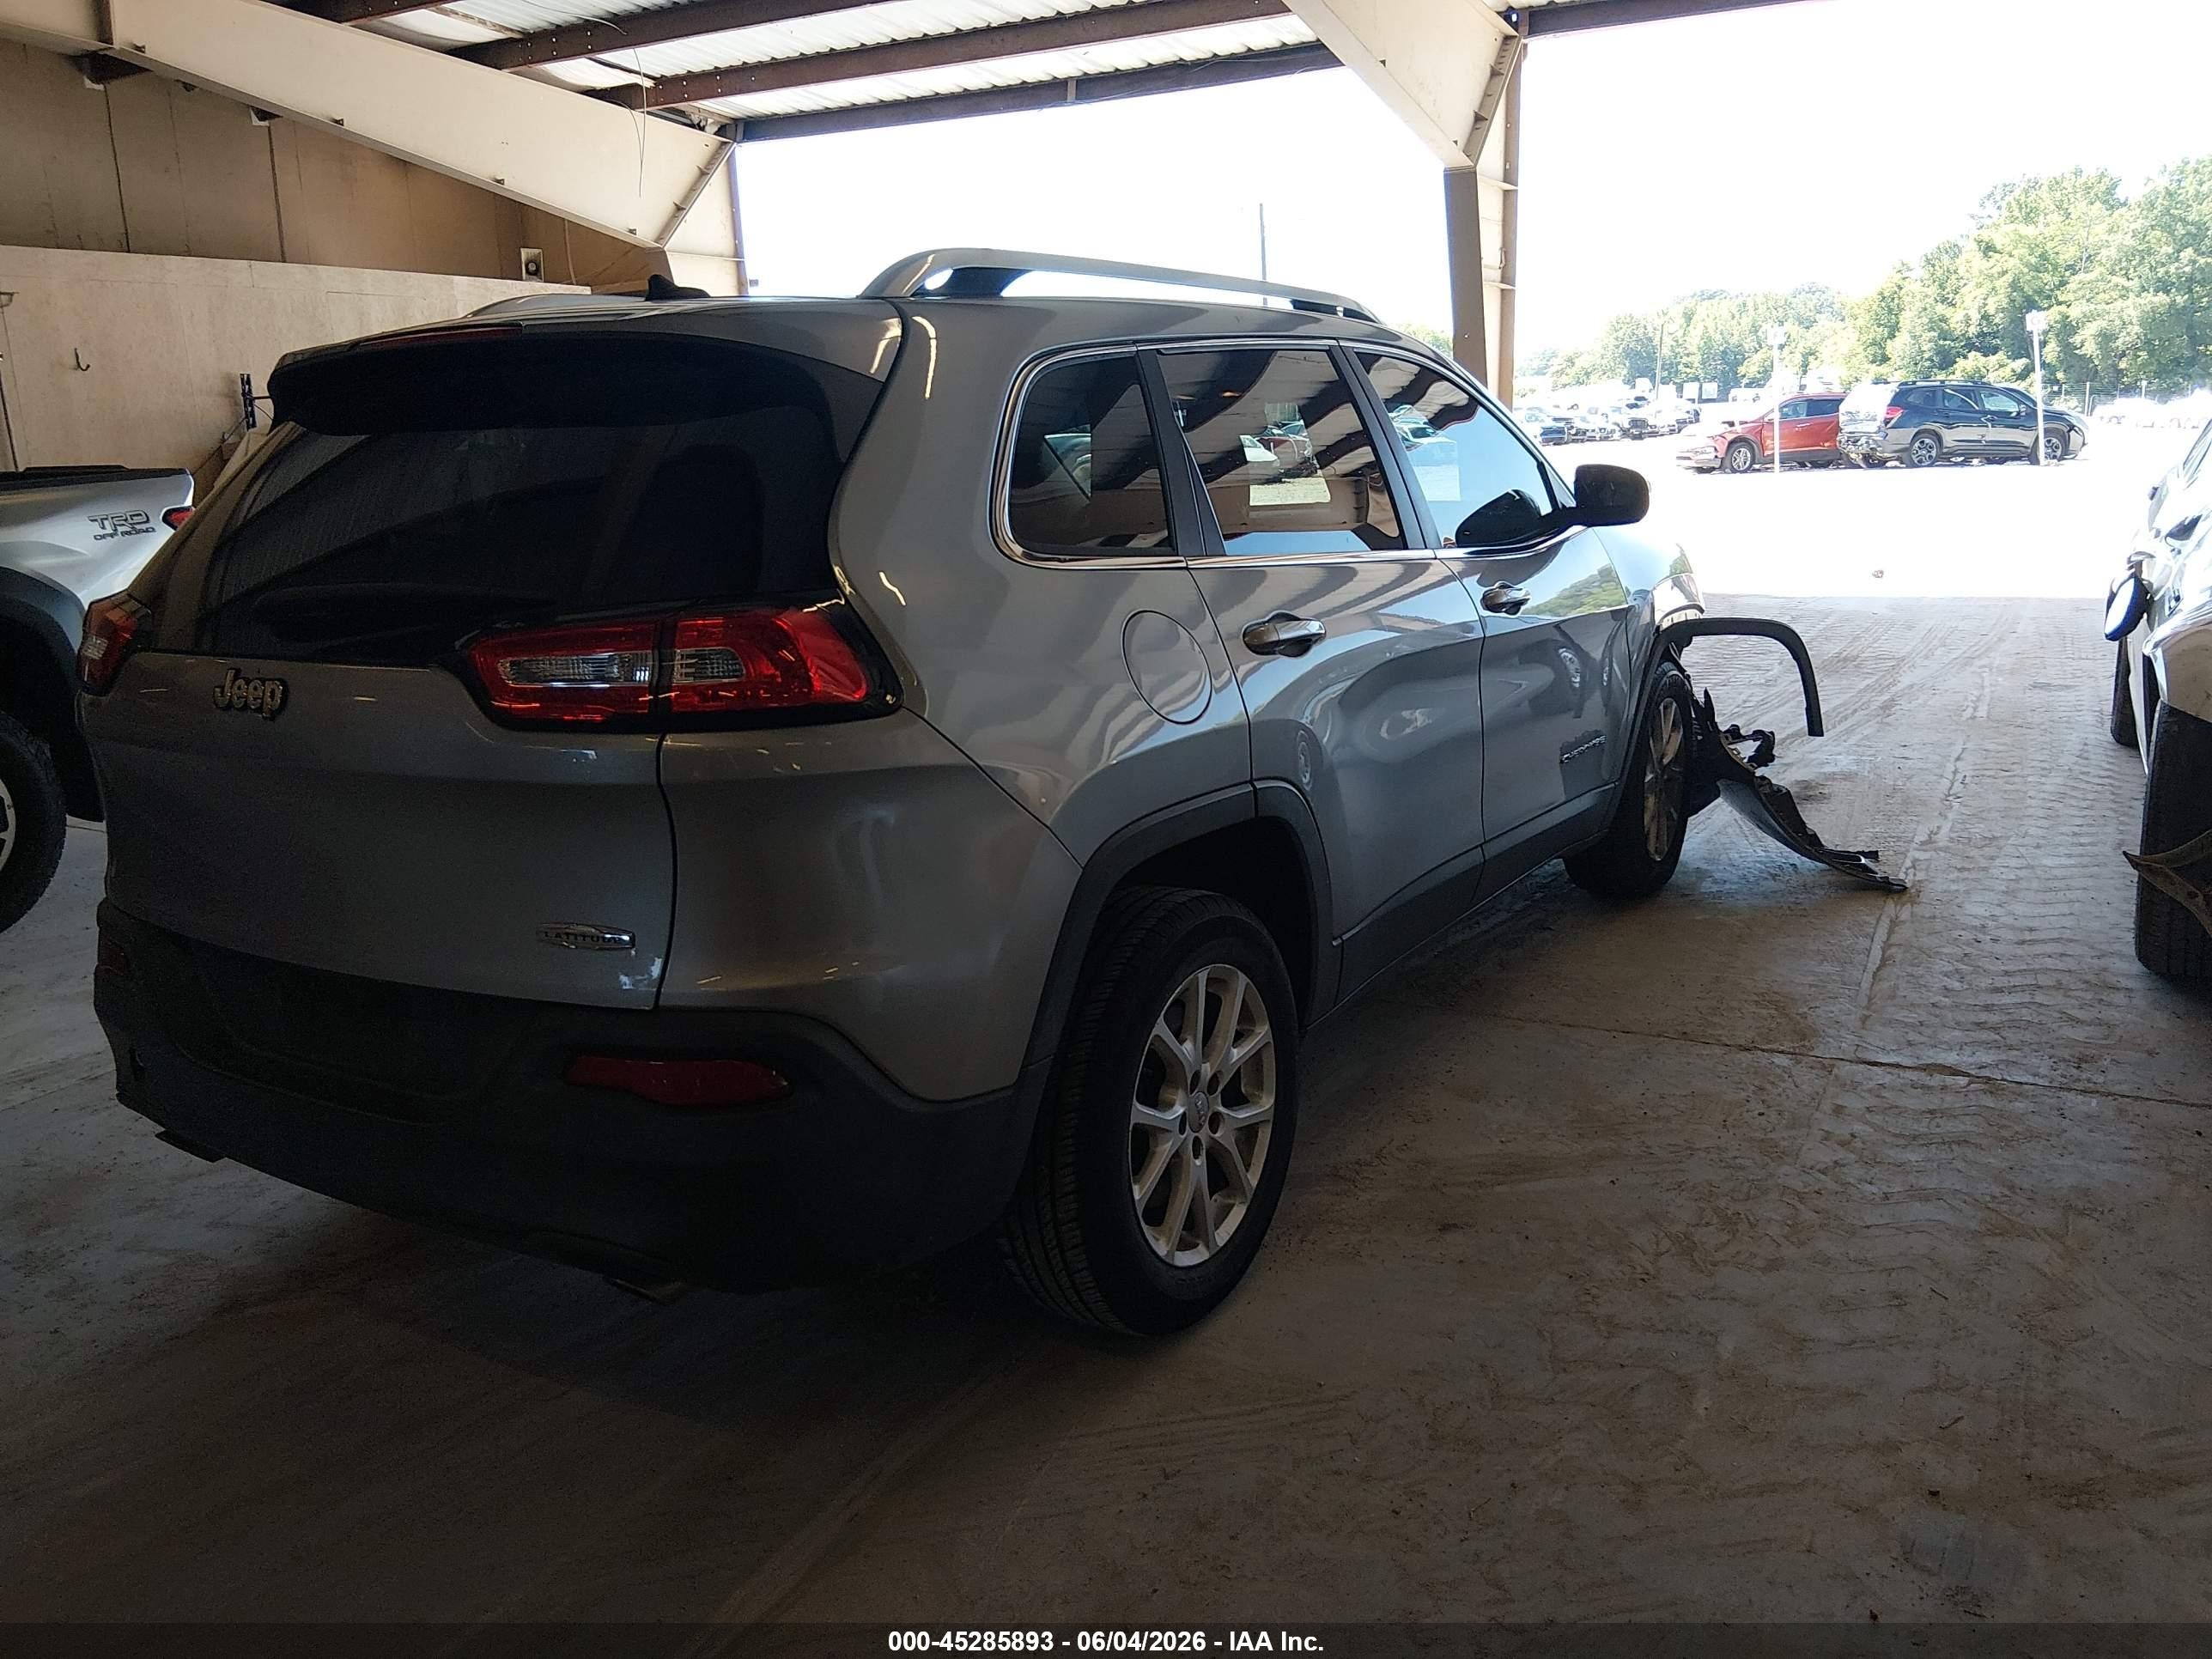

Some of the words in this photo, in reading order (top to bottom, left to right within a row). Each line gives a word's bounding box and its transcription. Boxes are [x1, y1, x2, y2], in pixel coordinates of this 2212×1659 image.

[88, 509, 150, 532] TRD
[93, 531, 119, 541] OFF
[120, 526, 156, 538] ROAD
[214, 669, 283, 718] Jeep
